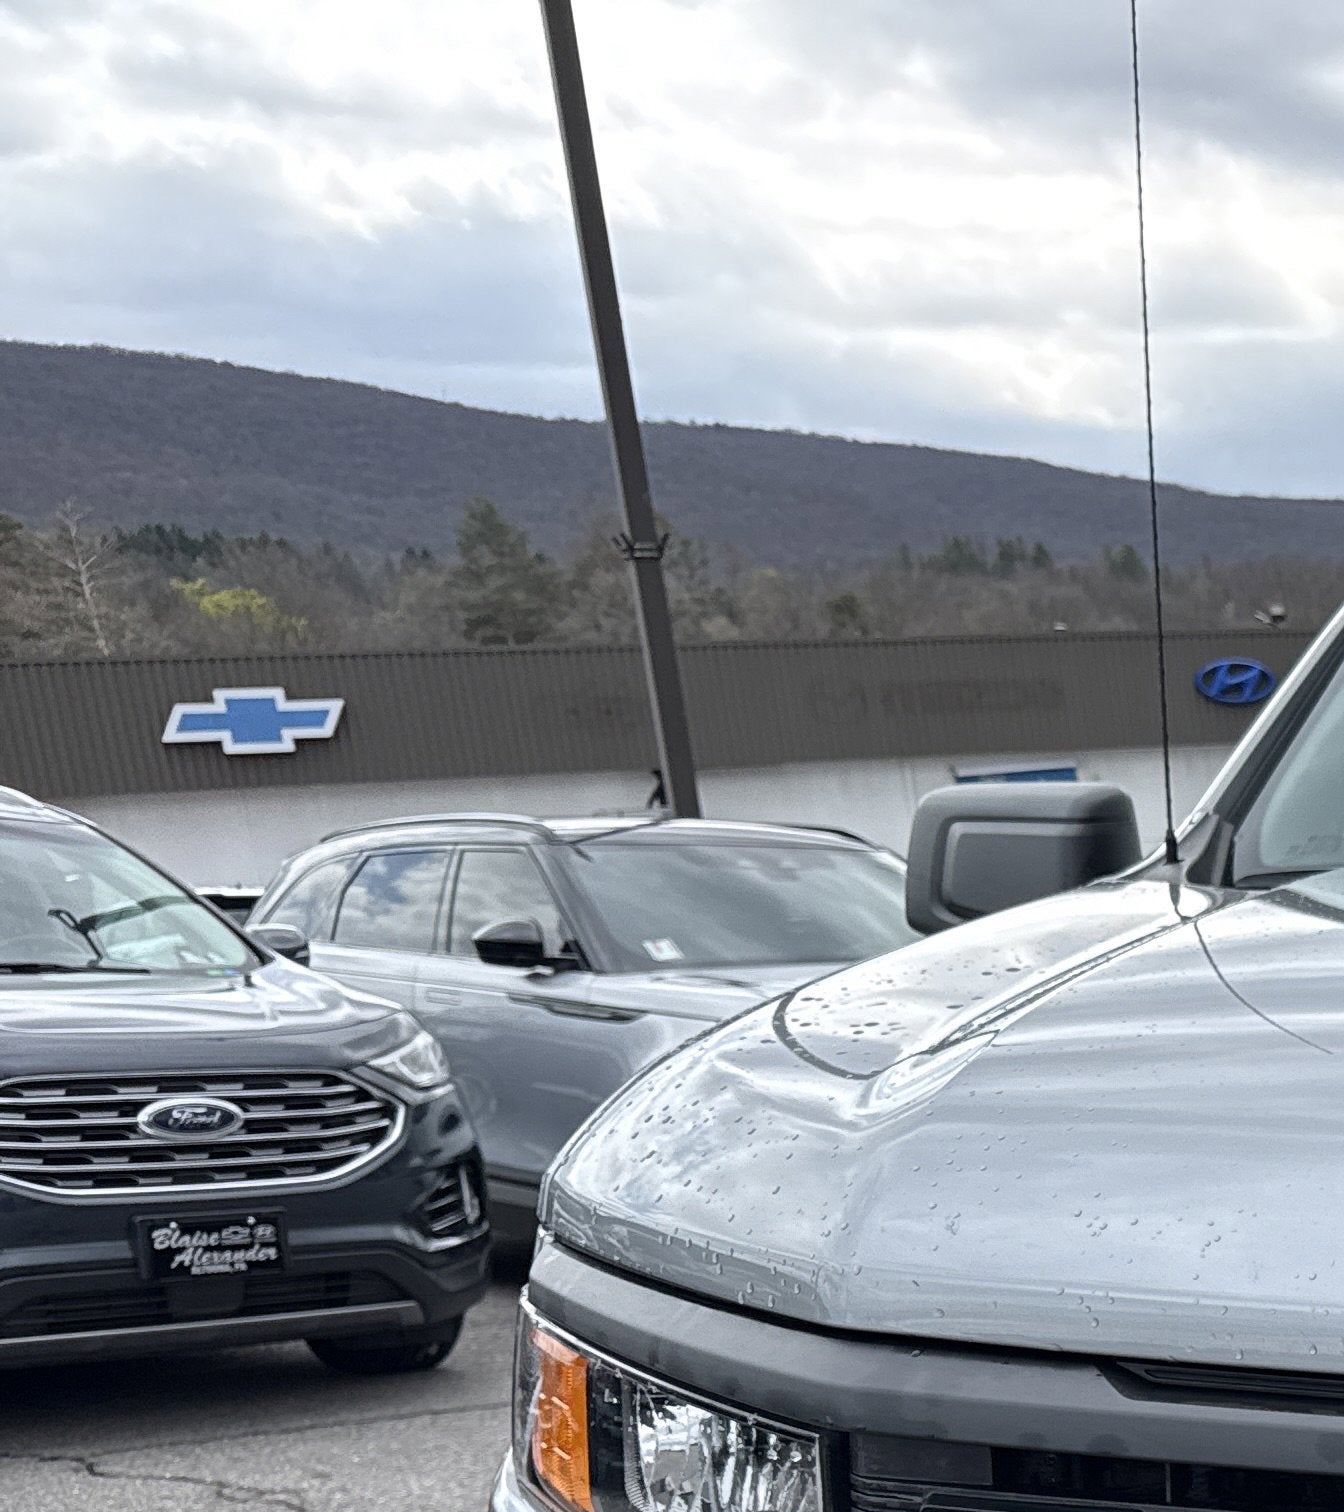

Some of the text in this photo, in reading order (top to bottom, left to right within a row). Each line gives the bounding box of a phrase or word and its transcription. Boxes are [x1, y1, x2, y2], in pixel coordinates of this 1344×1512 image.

[168, 1107, 221, 1125] Ford
[151, 1227, 220, 1250] Blaise
[170, 1243, 279, 1269] Alexander
